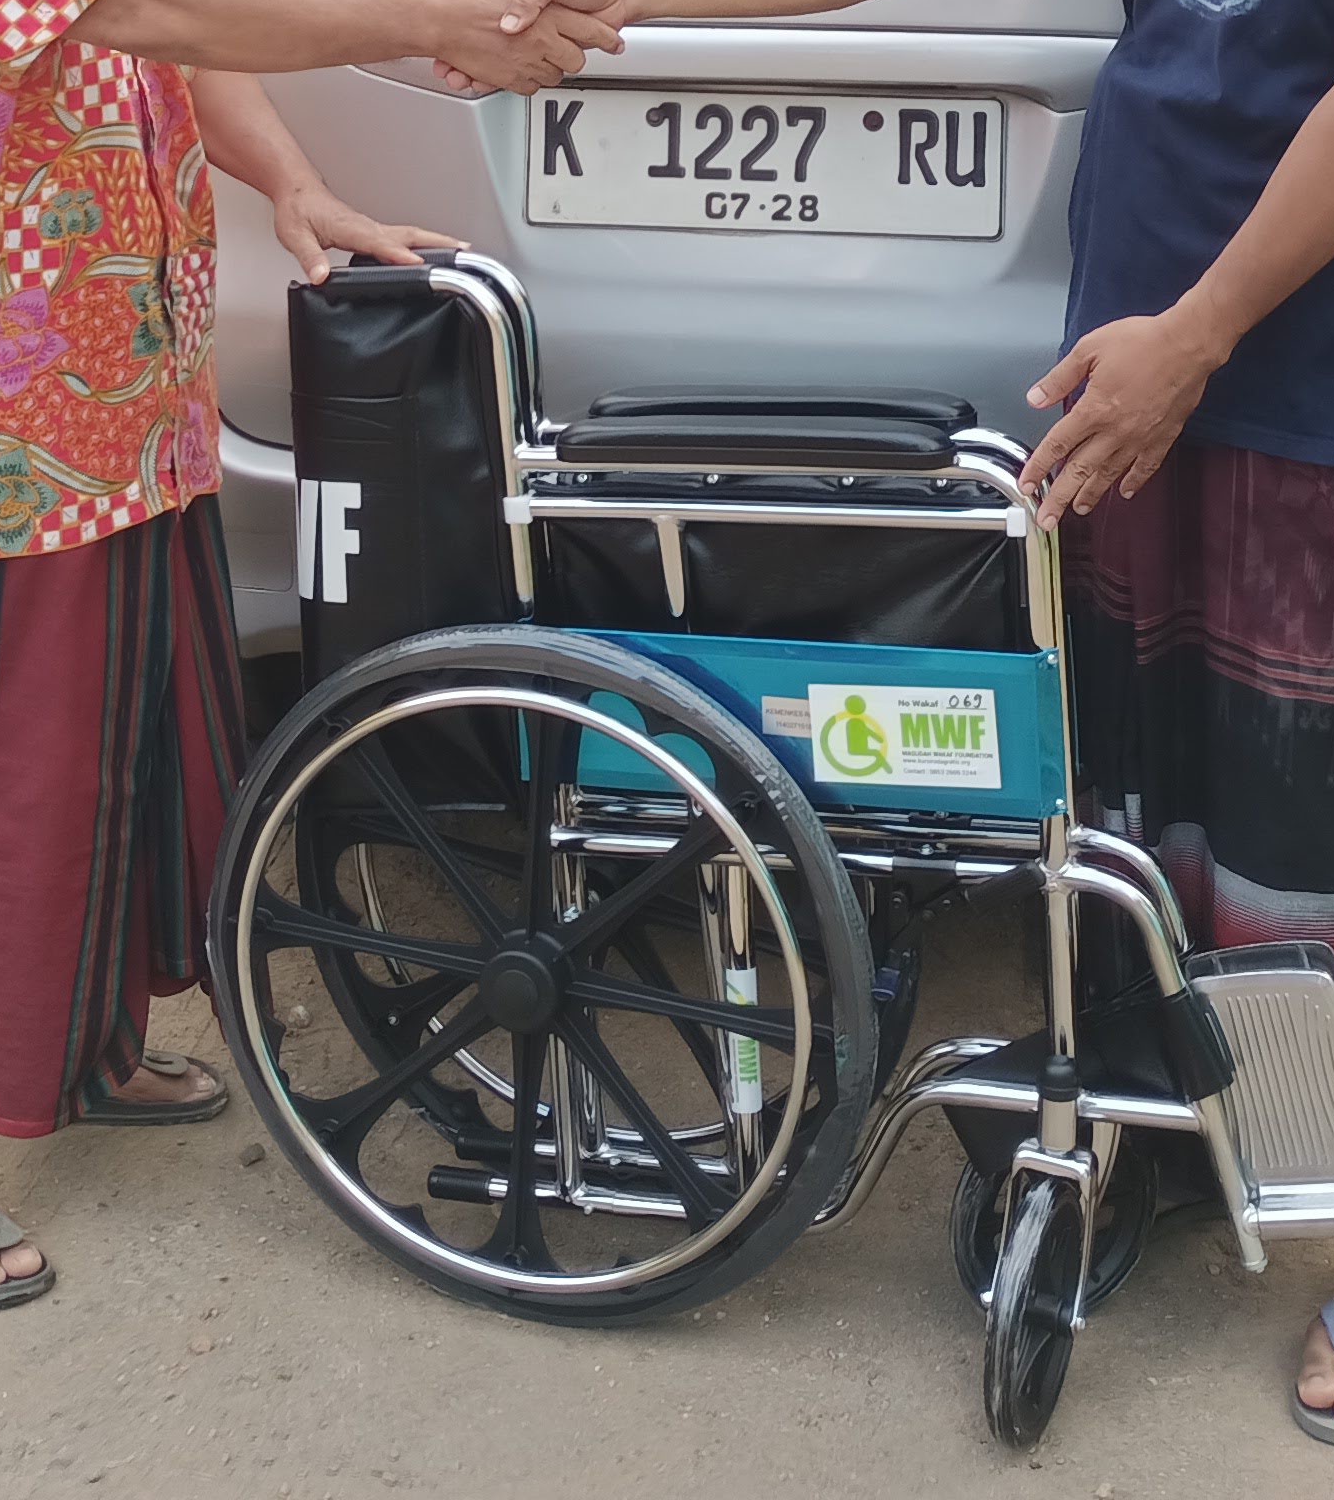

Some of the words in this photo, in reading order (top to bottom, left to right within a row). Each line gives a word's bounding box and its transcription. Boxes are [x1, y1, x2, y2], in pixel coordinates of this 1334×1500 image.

[542, 99, 585, 177] K
[647, 101, 828, 184] 1227
[897, 108, 988, 188] RU
[948, 693, 983, 709] 069
[899, 712, 986, 750] MWF
